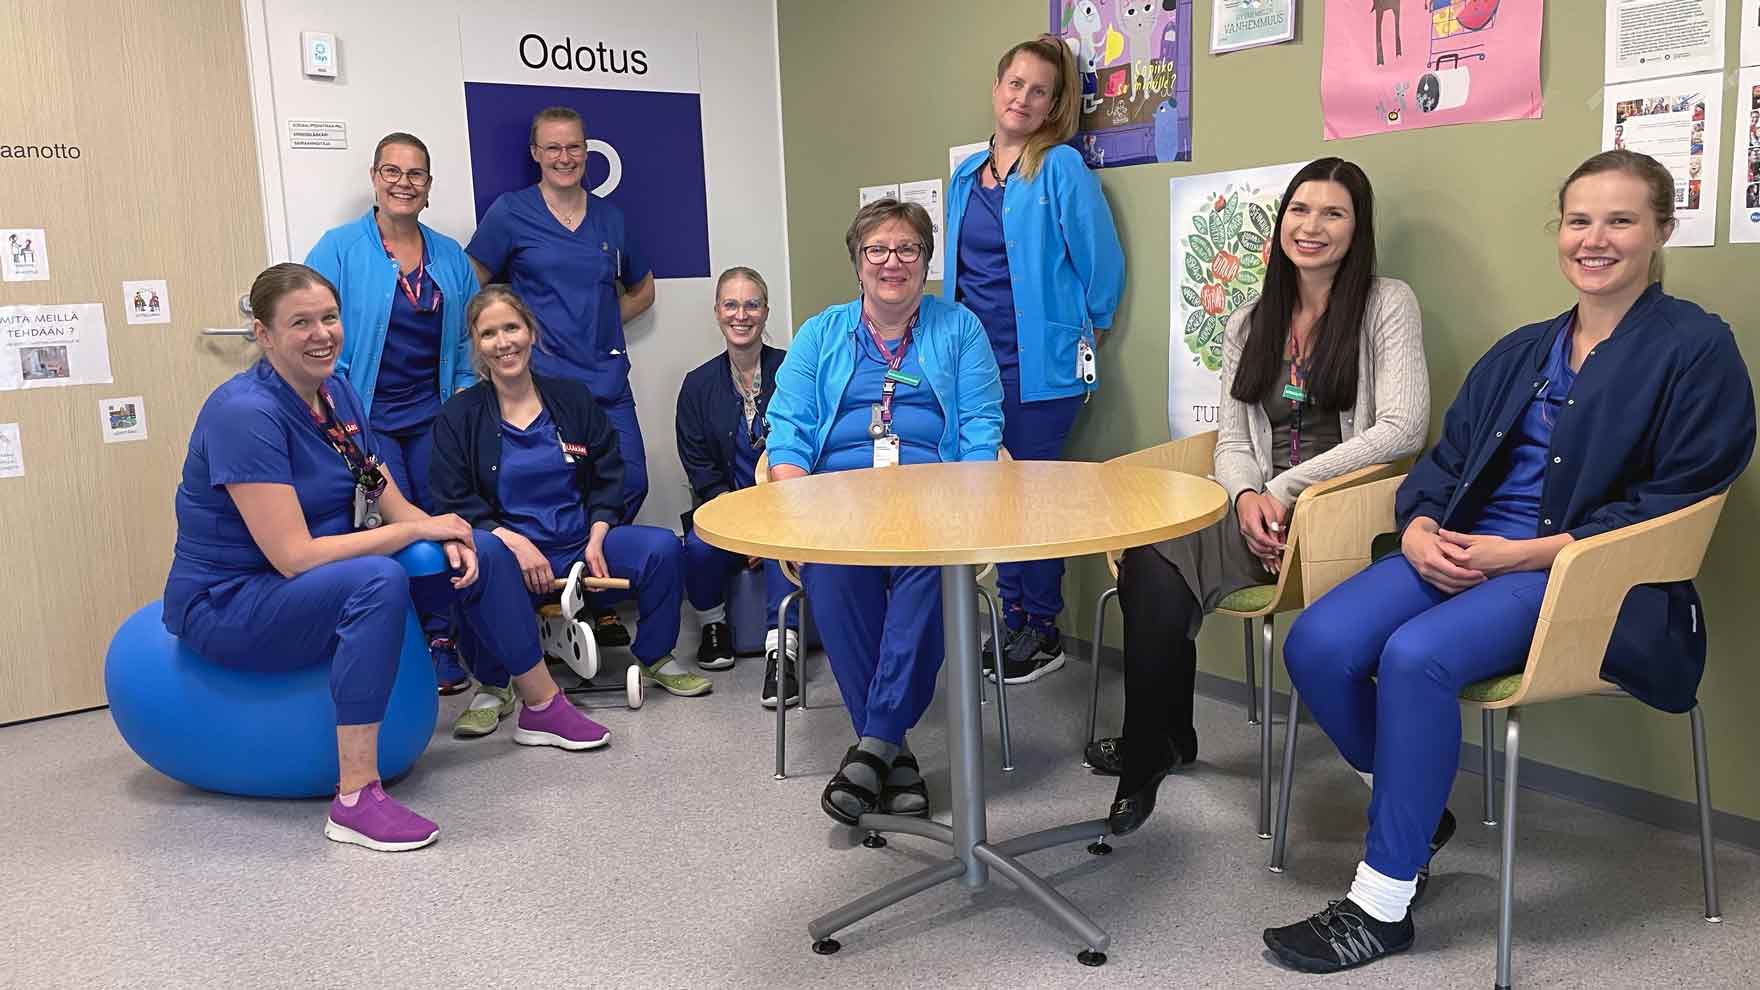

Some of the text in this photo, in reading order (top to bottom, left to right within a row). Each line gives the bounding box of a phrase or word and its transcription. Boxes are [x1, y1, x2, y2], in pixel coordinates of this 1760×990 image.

[1224, 14, 1284, 34] VANHEMMUUS
[519, 33, 648, 75] Odotus
[34, 311, 79, 323] MEILLÄ
[8, 325, 65, 338] TEHDÄÄN
